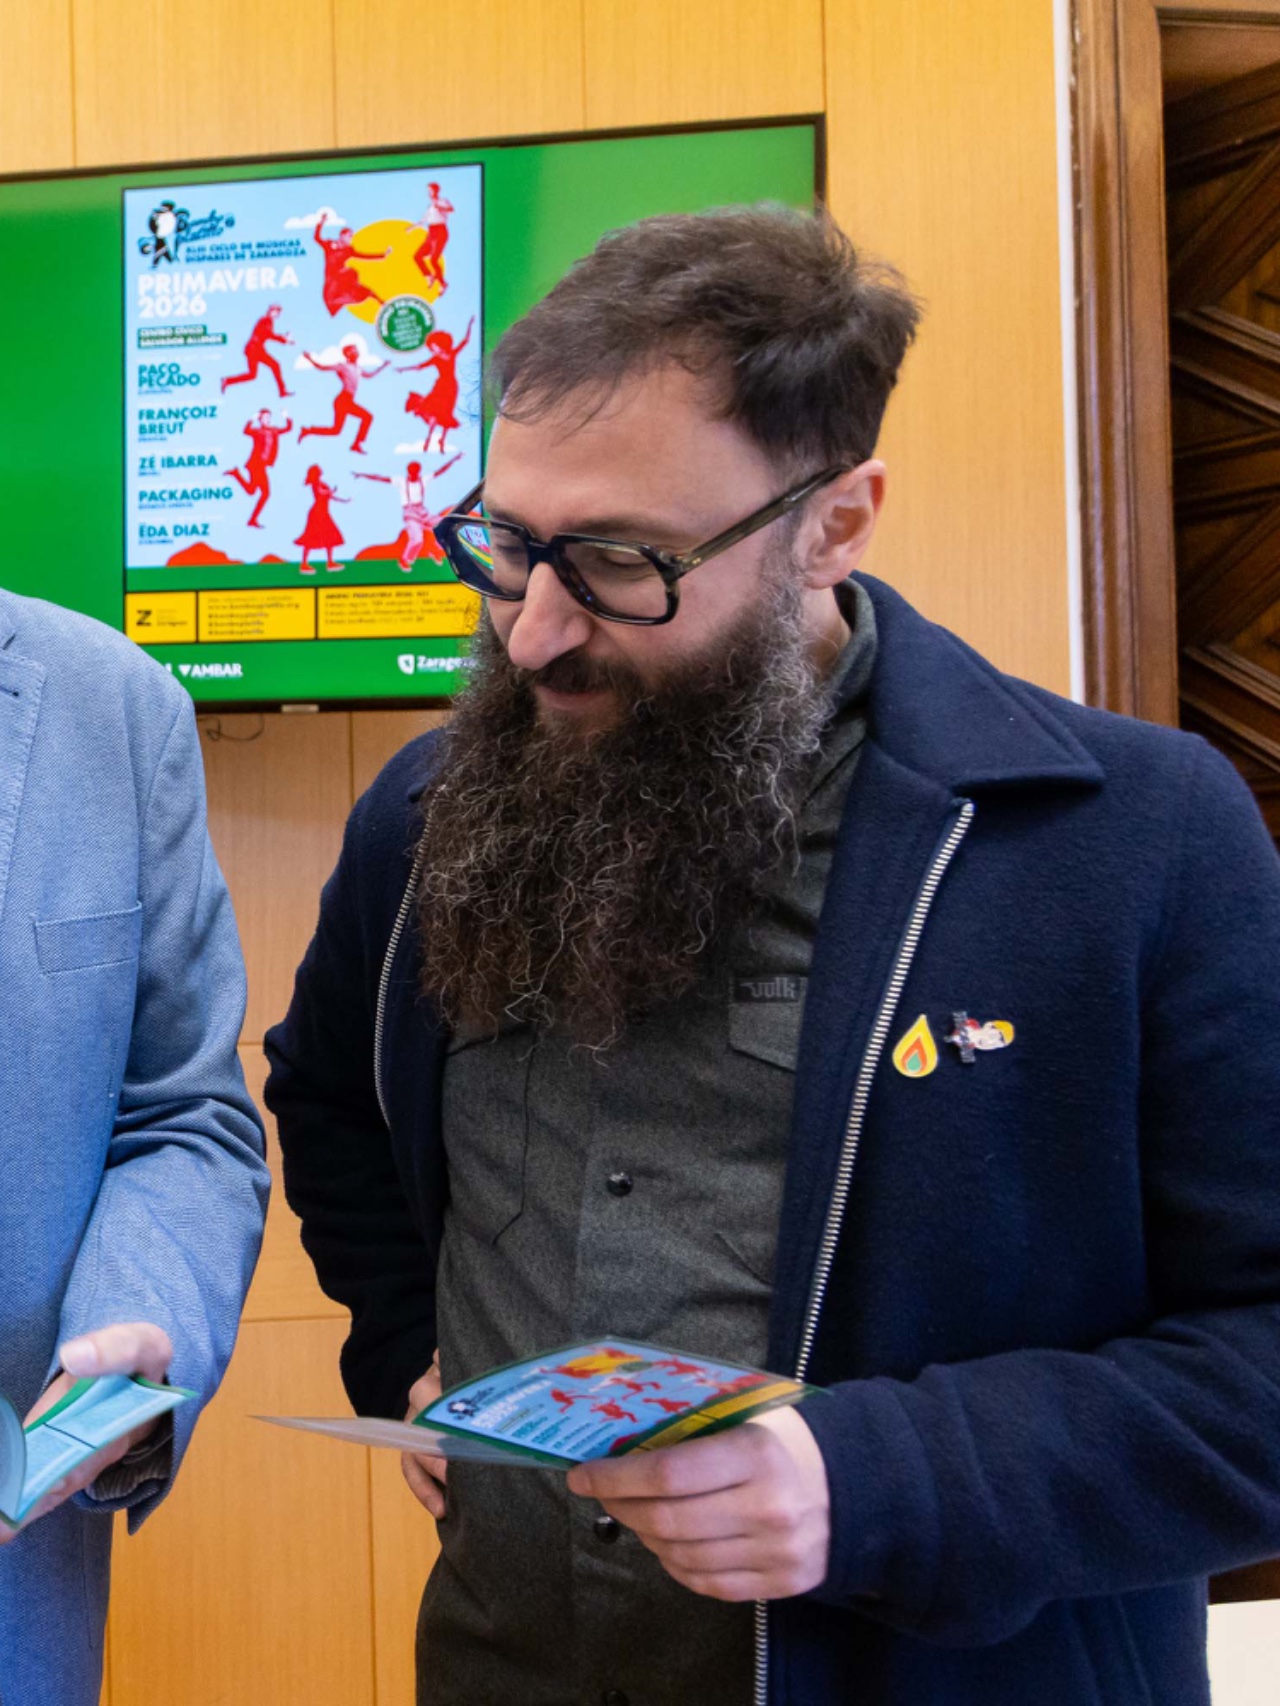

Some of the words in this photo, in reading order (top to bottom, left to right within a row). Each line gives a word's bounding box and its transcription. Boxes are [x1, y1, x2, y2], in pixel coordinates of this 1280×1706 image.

[138, 265, 300, 296] PRIMAVERA
[138, 295, 207, 318] 2026
[138, 363, 180, 376] PACO
[138, 373, 201, 388] PECADO
[138, 405, 218, 421] FRANÇOIZ
[138, 421, 184, 435] BREUT
[139, 453, 156, 469] ZÉ
[161, 454, 218, 468] IBARRA
[138, 487, 234, 502] PACKAGING
[173, 523, 210, 537] DIAZ
[136, 609, 152, 627] Z
[191, 663, 243, 678] AMBAR
